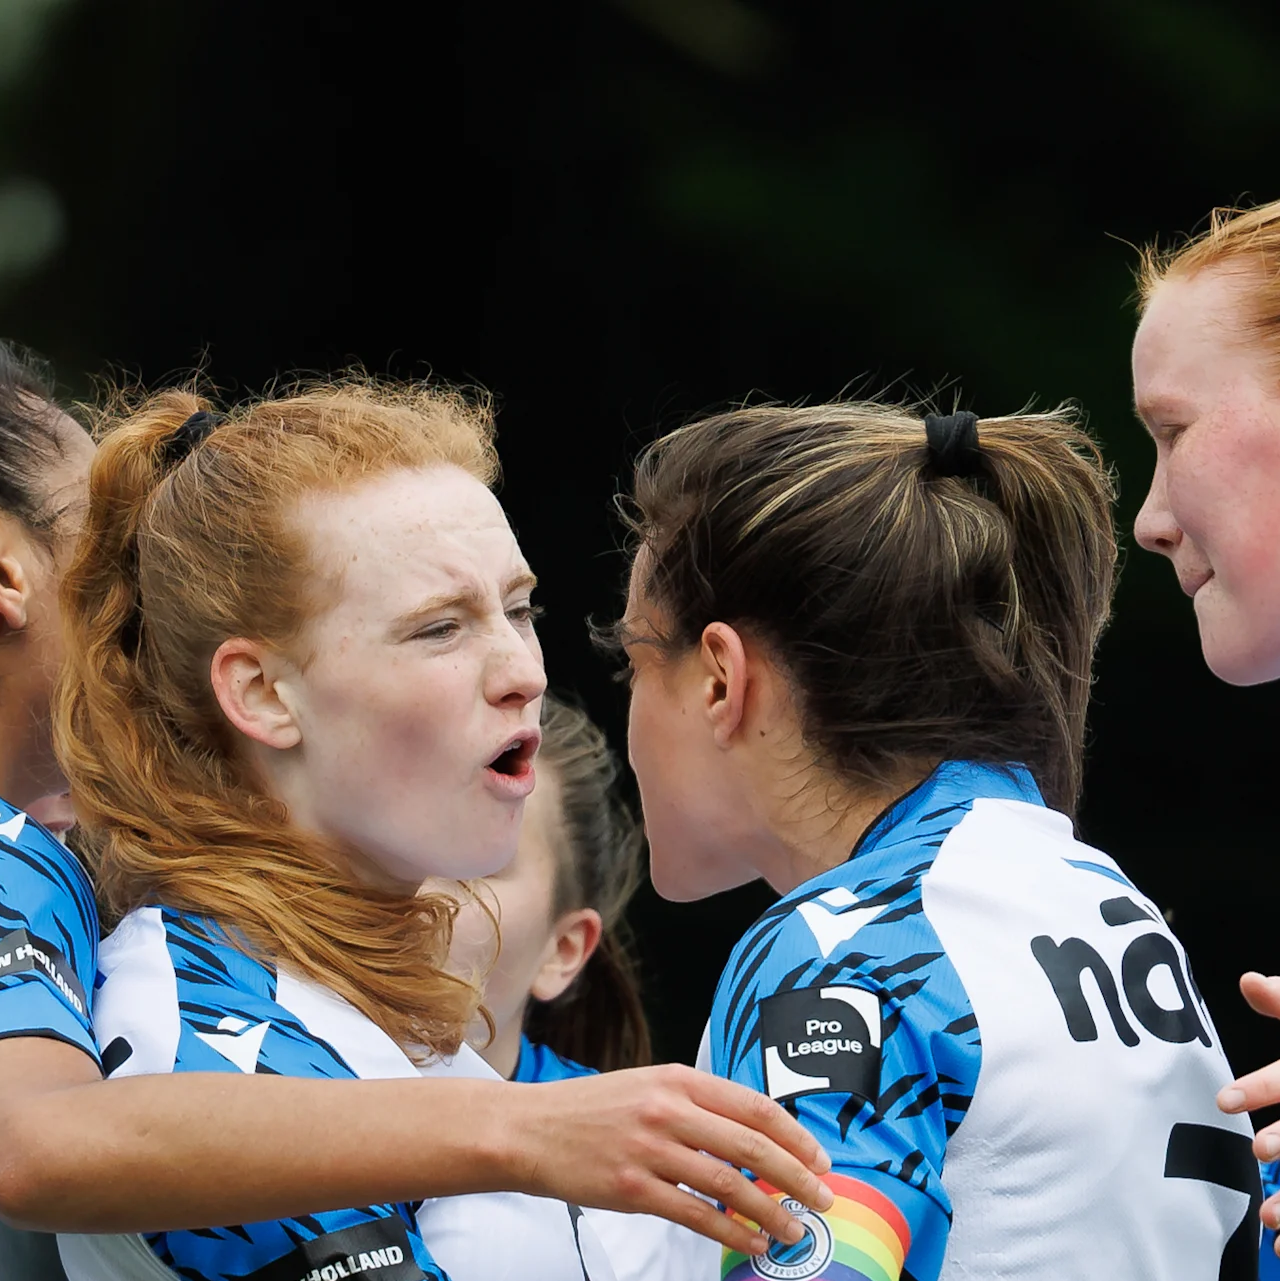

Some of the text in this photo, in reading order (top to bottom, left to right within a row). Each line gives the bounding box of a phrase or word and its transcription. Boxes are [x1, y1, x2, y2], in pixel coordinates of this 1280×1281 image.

[14, 943, 84, 1014] HOLLAND
[805, 1019, 842, 1036] Pro
[786, 1038, 863, 1058] League
